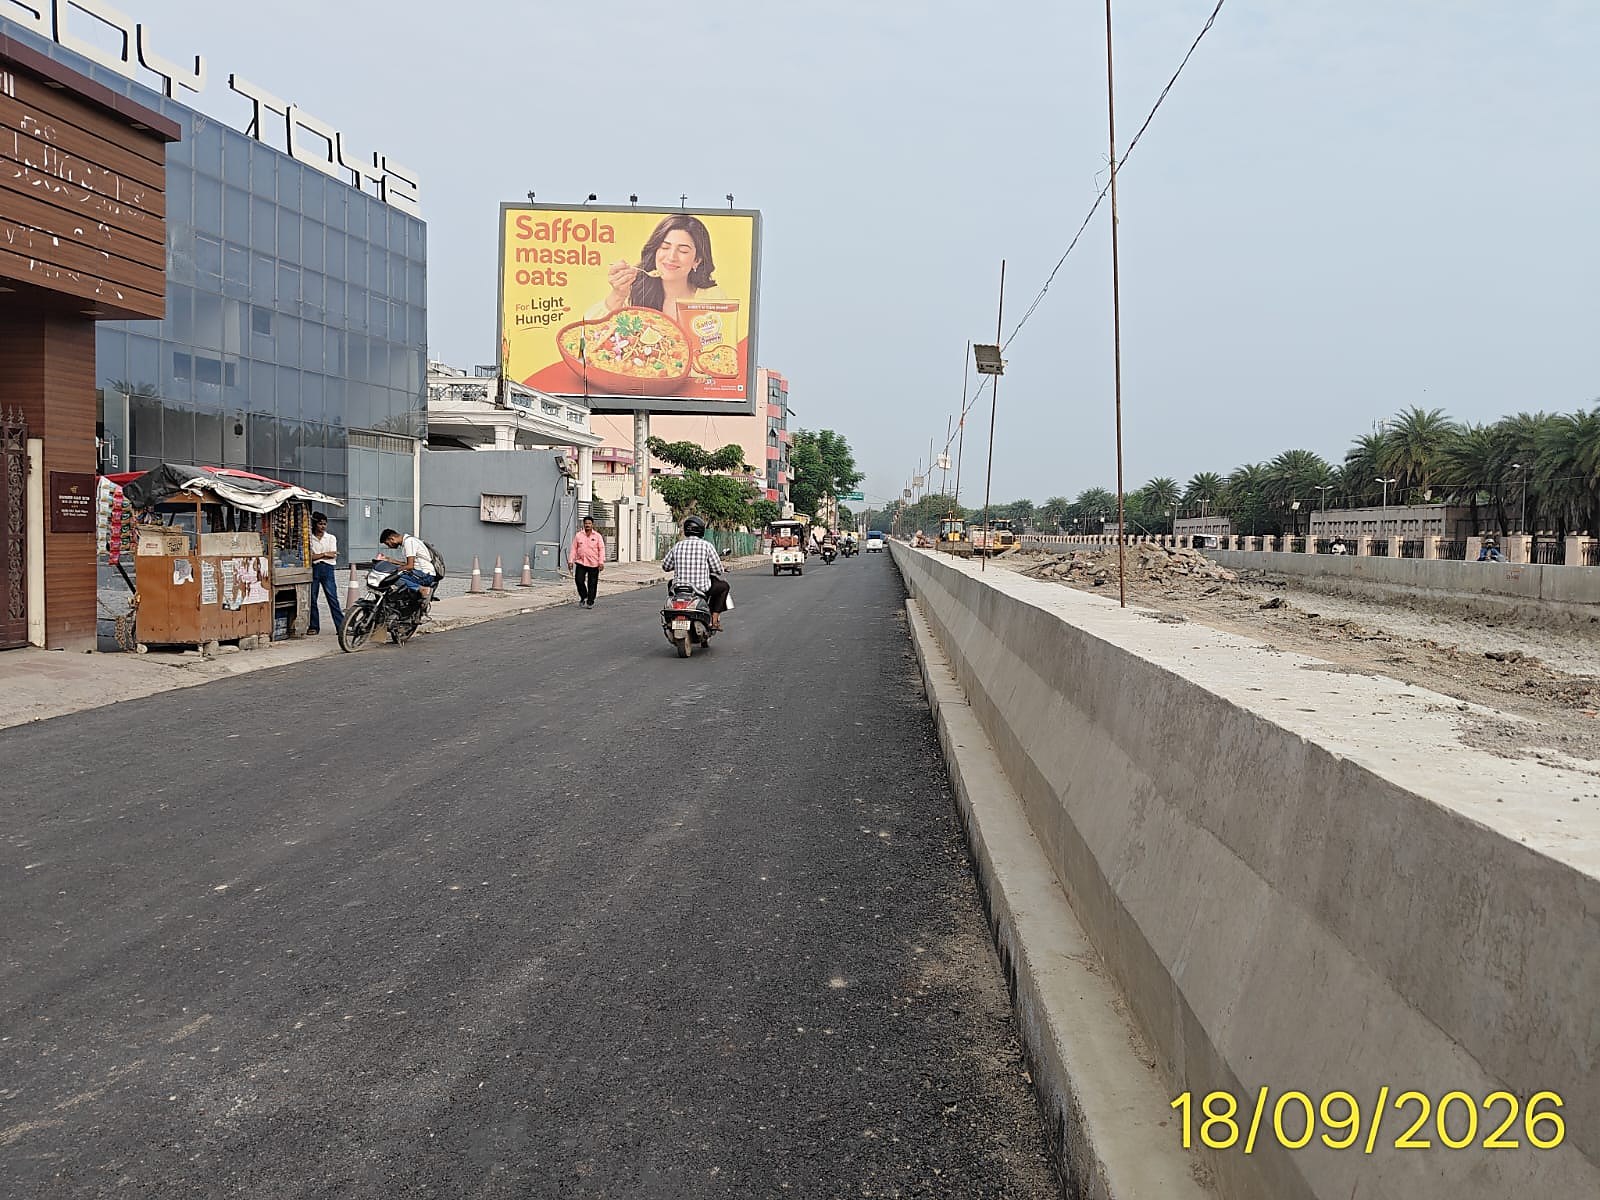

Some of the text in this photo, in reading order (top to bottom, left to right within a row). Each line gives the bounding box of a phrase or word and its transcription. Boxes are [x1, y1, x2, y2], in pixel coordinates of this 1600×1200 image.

[515, 215, 615, 244] Saffola
[515, 244, 602, 266] masala
[515, 267, 568, 287] oats
[515, 296, 564, 312] For Light
[515, 312, 564, 326] Hunger
